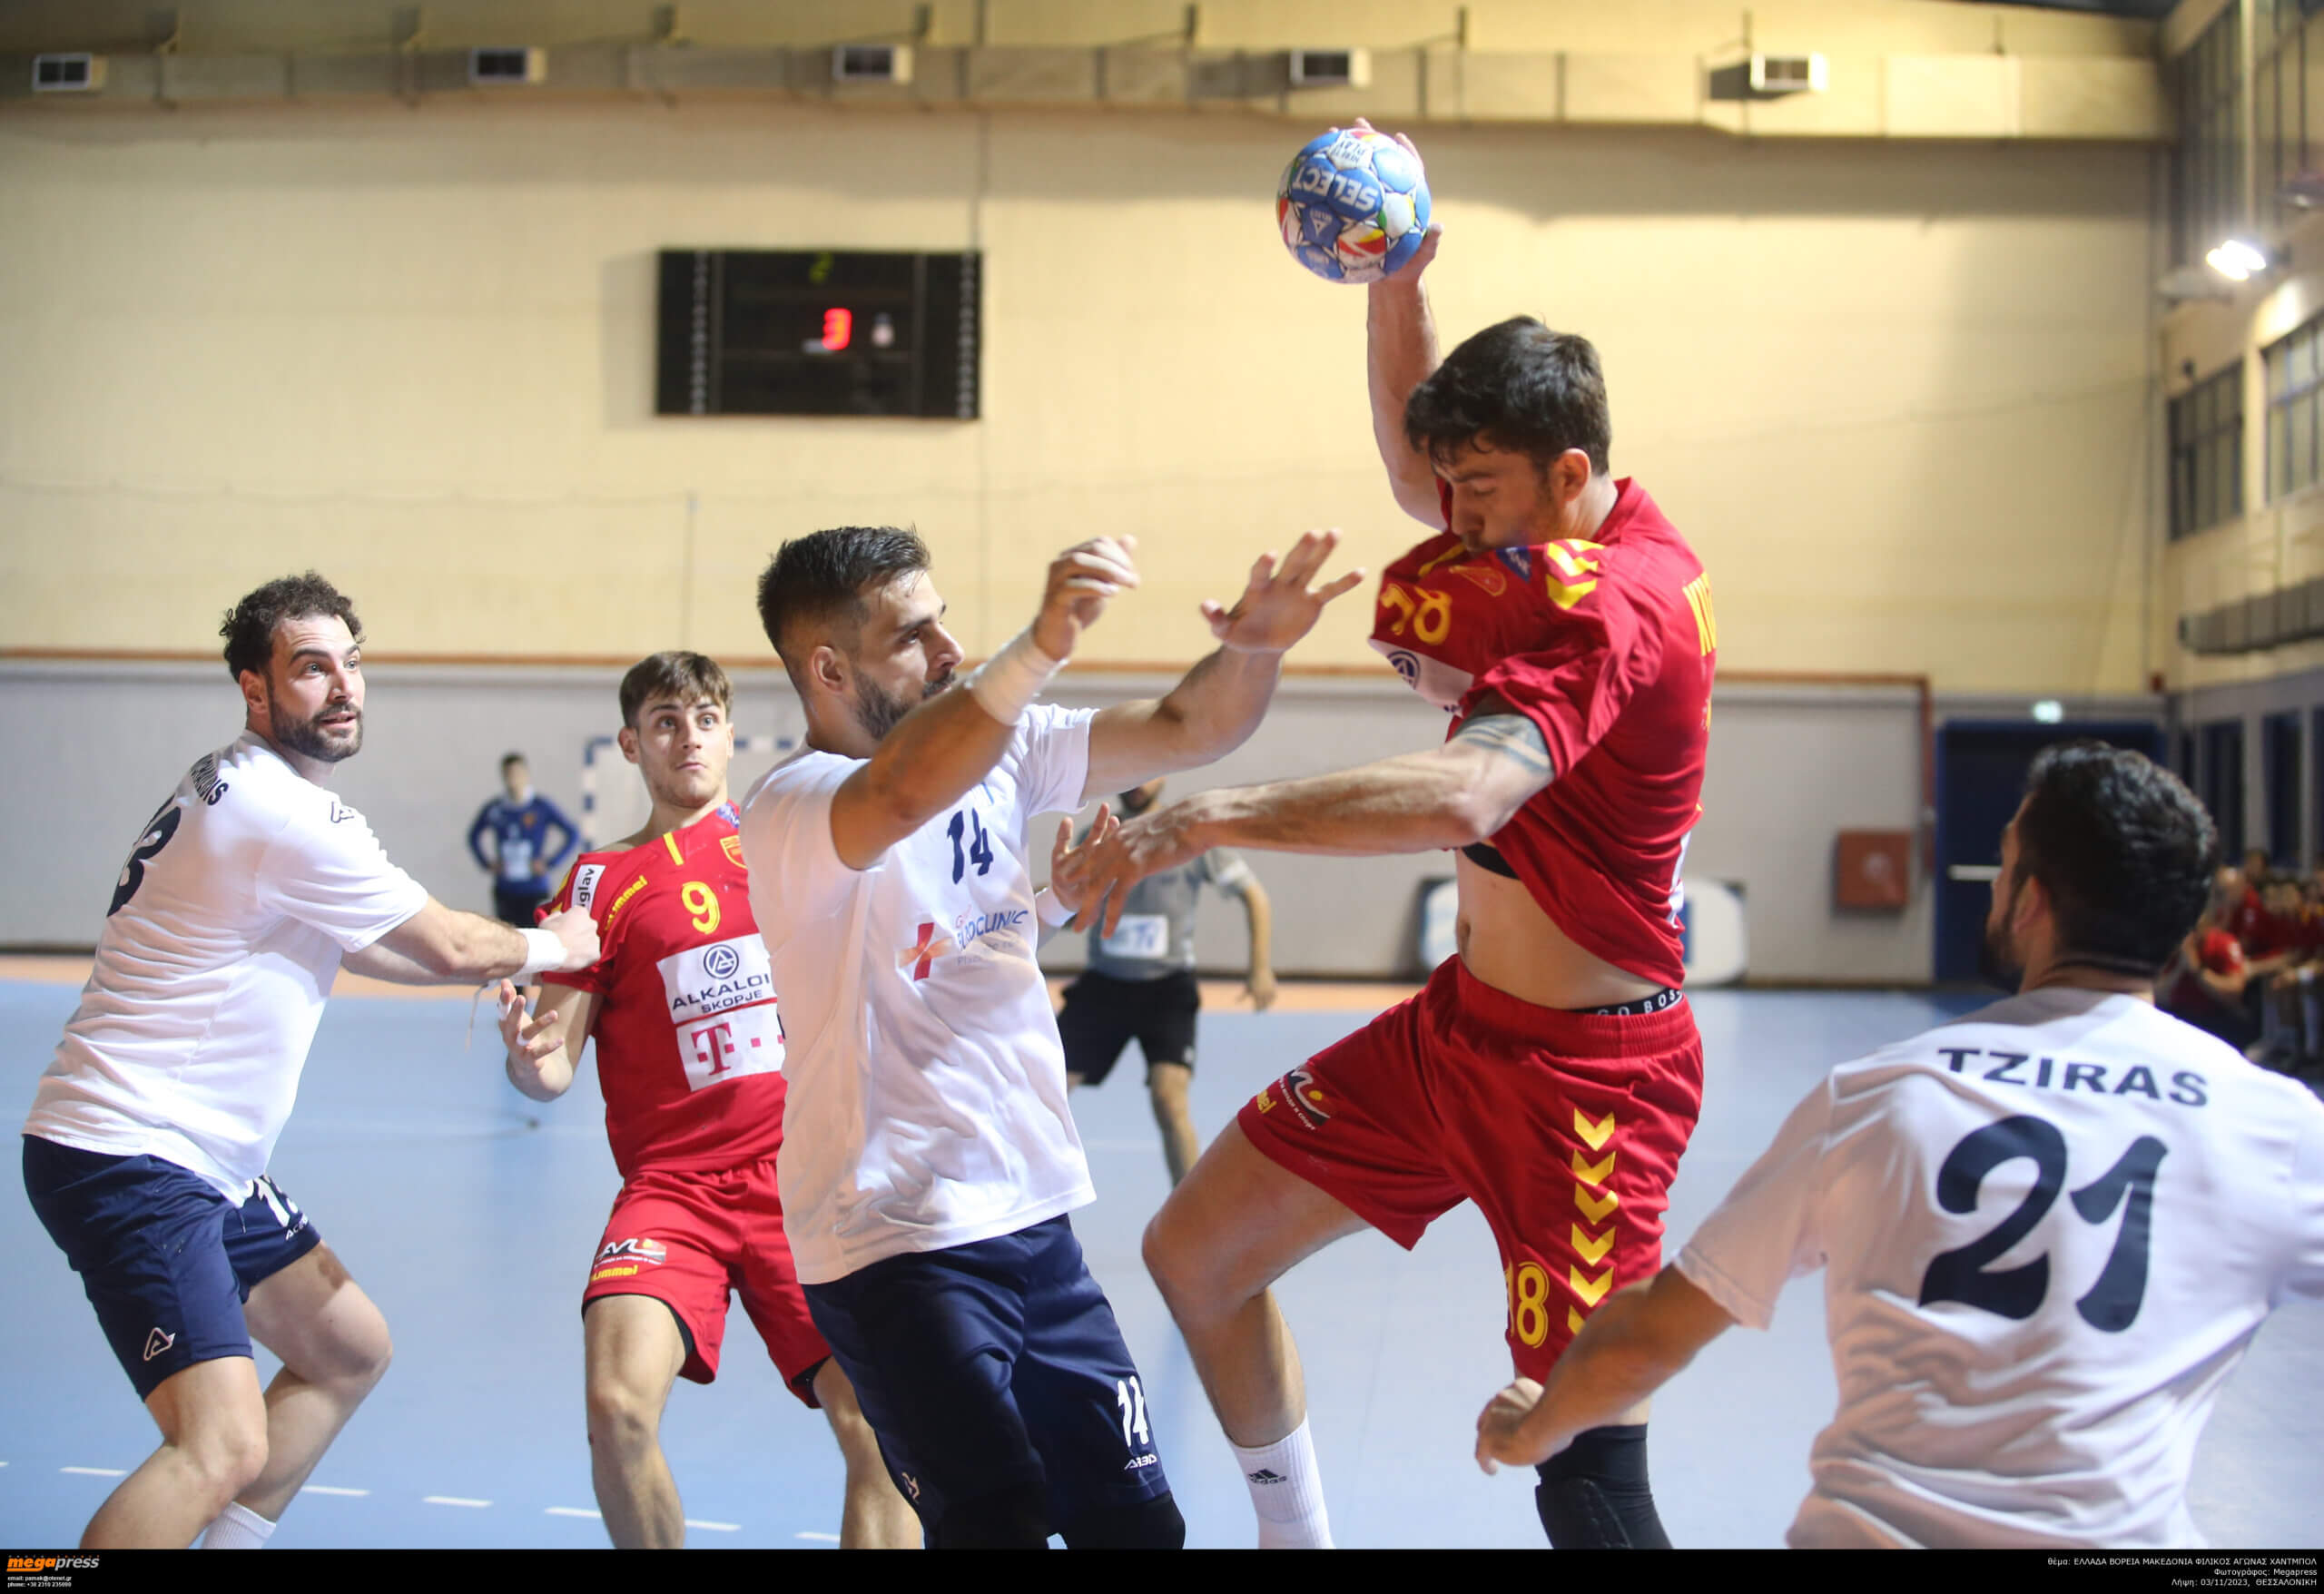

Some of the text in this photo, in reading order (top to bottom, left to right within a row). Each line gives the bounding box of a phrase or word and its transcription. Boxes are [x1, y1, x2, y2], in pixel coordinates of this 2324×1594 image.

[1292, 167, 1380, 212] SELECT
[947, 807, 993, 885] 14
[578, 868, 595, 908] glav
[682, 881, 721, 935] 9
[673, 973, 770, 1010] ALKALOI
[701, 989, 763, 1014] SKOPJE
[1937, 1048, 2208, 1107] TZIRAS
[1918, 1114, 2169, 1333] 21
[1118, 1375, 1149, 1448] 14
